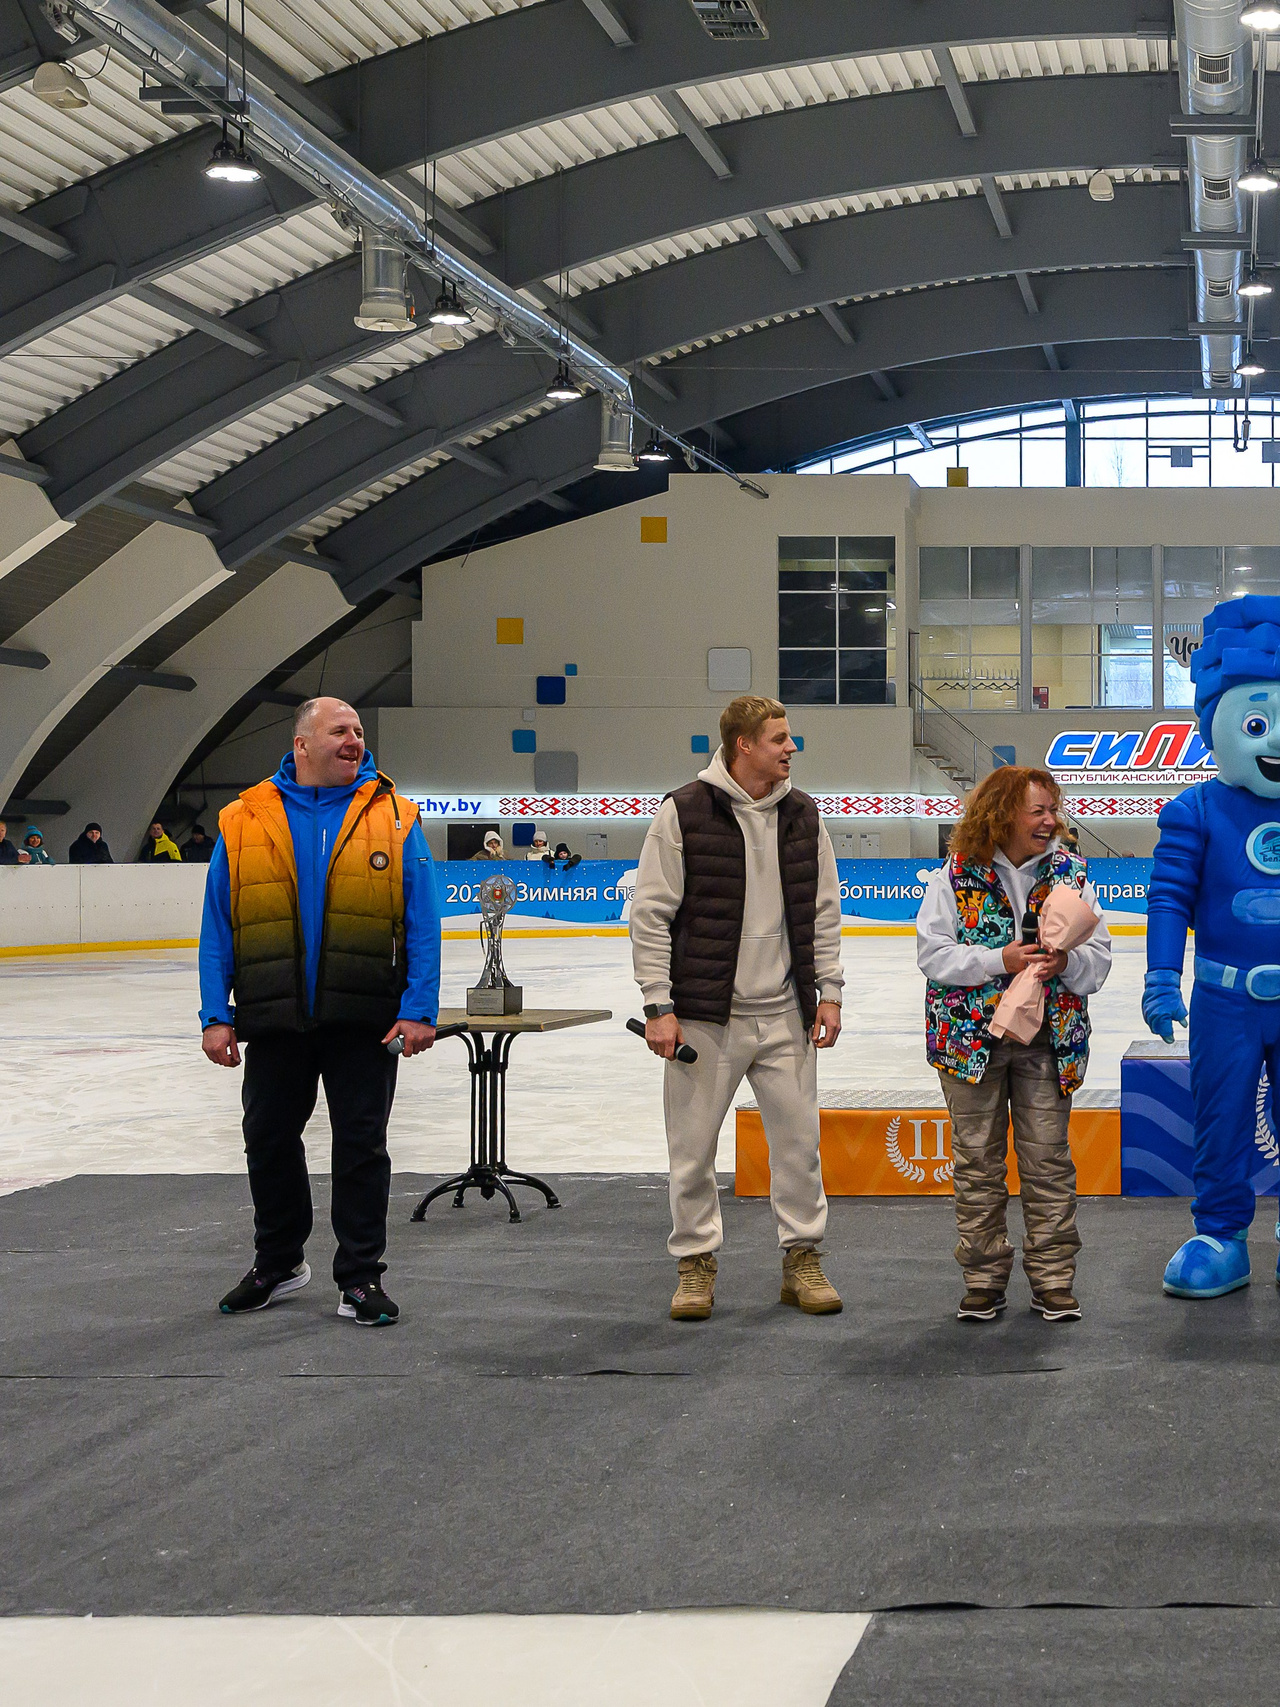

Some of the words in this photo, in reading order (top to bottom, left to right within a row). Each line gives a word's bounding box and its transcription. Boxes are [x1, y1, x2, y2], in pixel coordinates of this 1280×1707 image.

[1053, 770, 1176, 782] ЕСПУБЛИКАНСКИЙ
[410, 798, 482, 815] chy.by
[446, 884, 481, 903] 202
[516, 882, 597, 902] Зимняя
[839, 880, 928, 900] ботнико
[1091, 880, 1150, 903] прав
